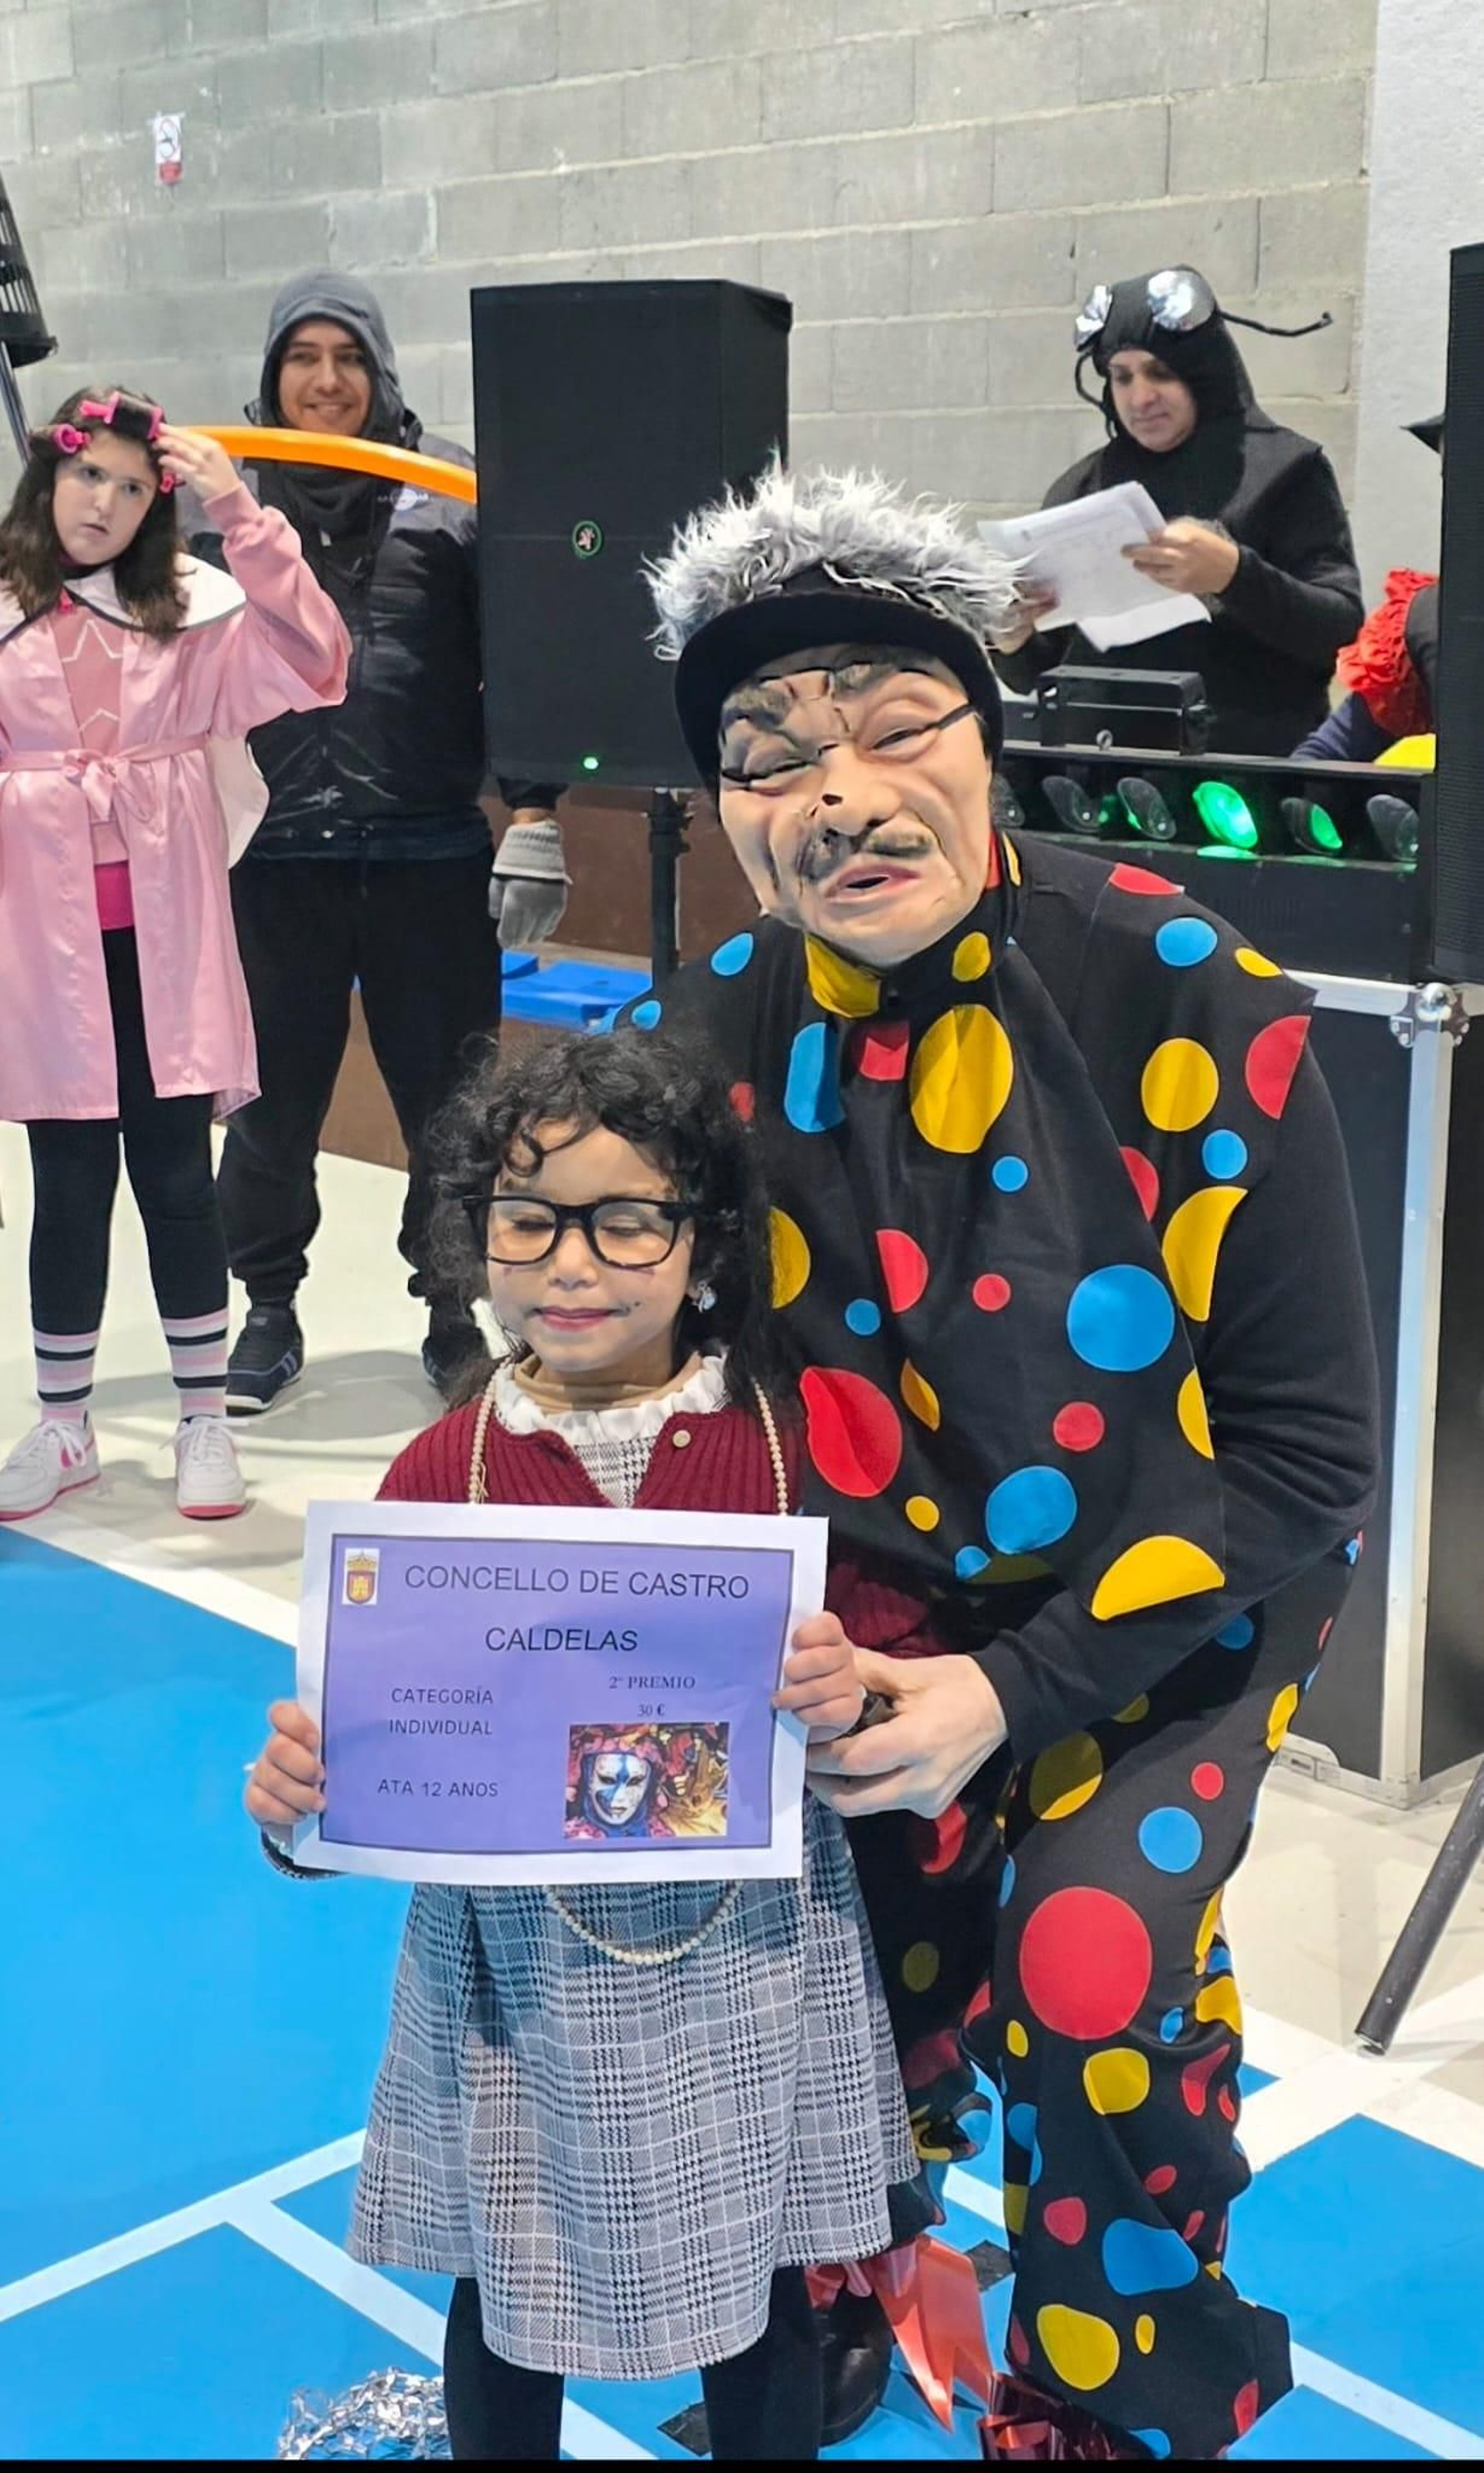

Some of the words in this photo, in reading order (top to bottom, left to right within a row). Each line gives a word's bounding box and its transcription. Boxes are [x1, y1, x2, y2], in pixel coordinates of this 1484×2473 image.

[404, 1564, 569, 1594] CONCELLO
[579, 1570, 620, 1595] DE
[628, 1571, 750, 1599] CASTRO
[484, 1626, 639, 1652] CALDELAS
[627, 1675, 697, 1690] PREMIO
[390, 1685, 493, 1705] CATEGORÍA
[637, 1704, 653, 1717] 30
[657, 1703, 665, 1717] €
[389, 1719, 493, 1736] INDIVIDUAL
[377, 1778, 414, 1795] ATA
[421, 1782, 442, 1798] 12
[447, 1782, 499, 1798] ANOS
